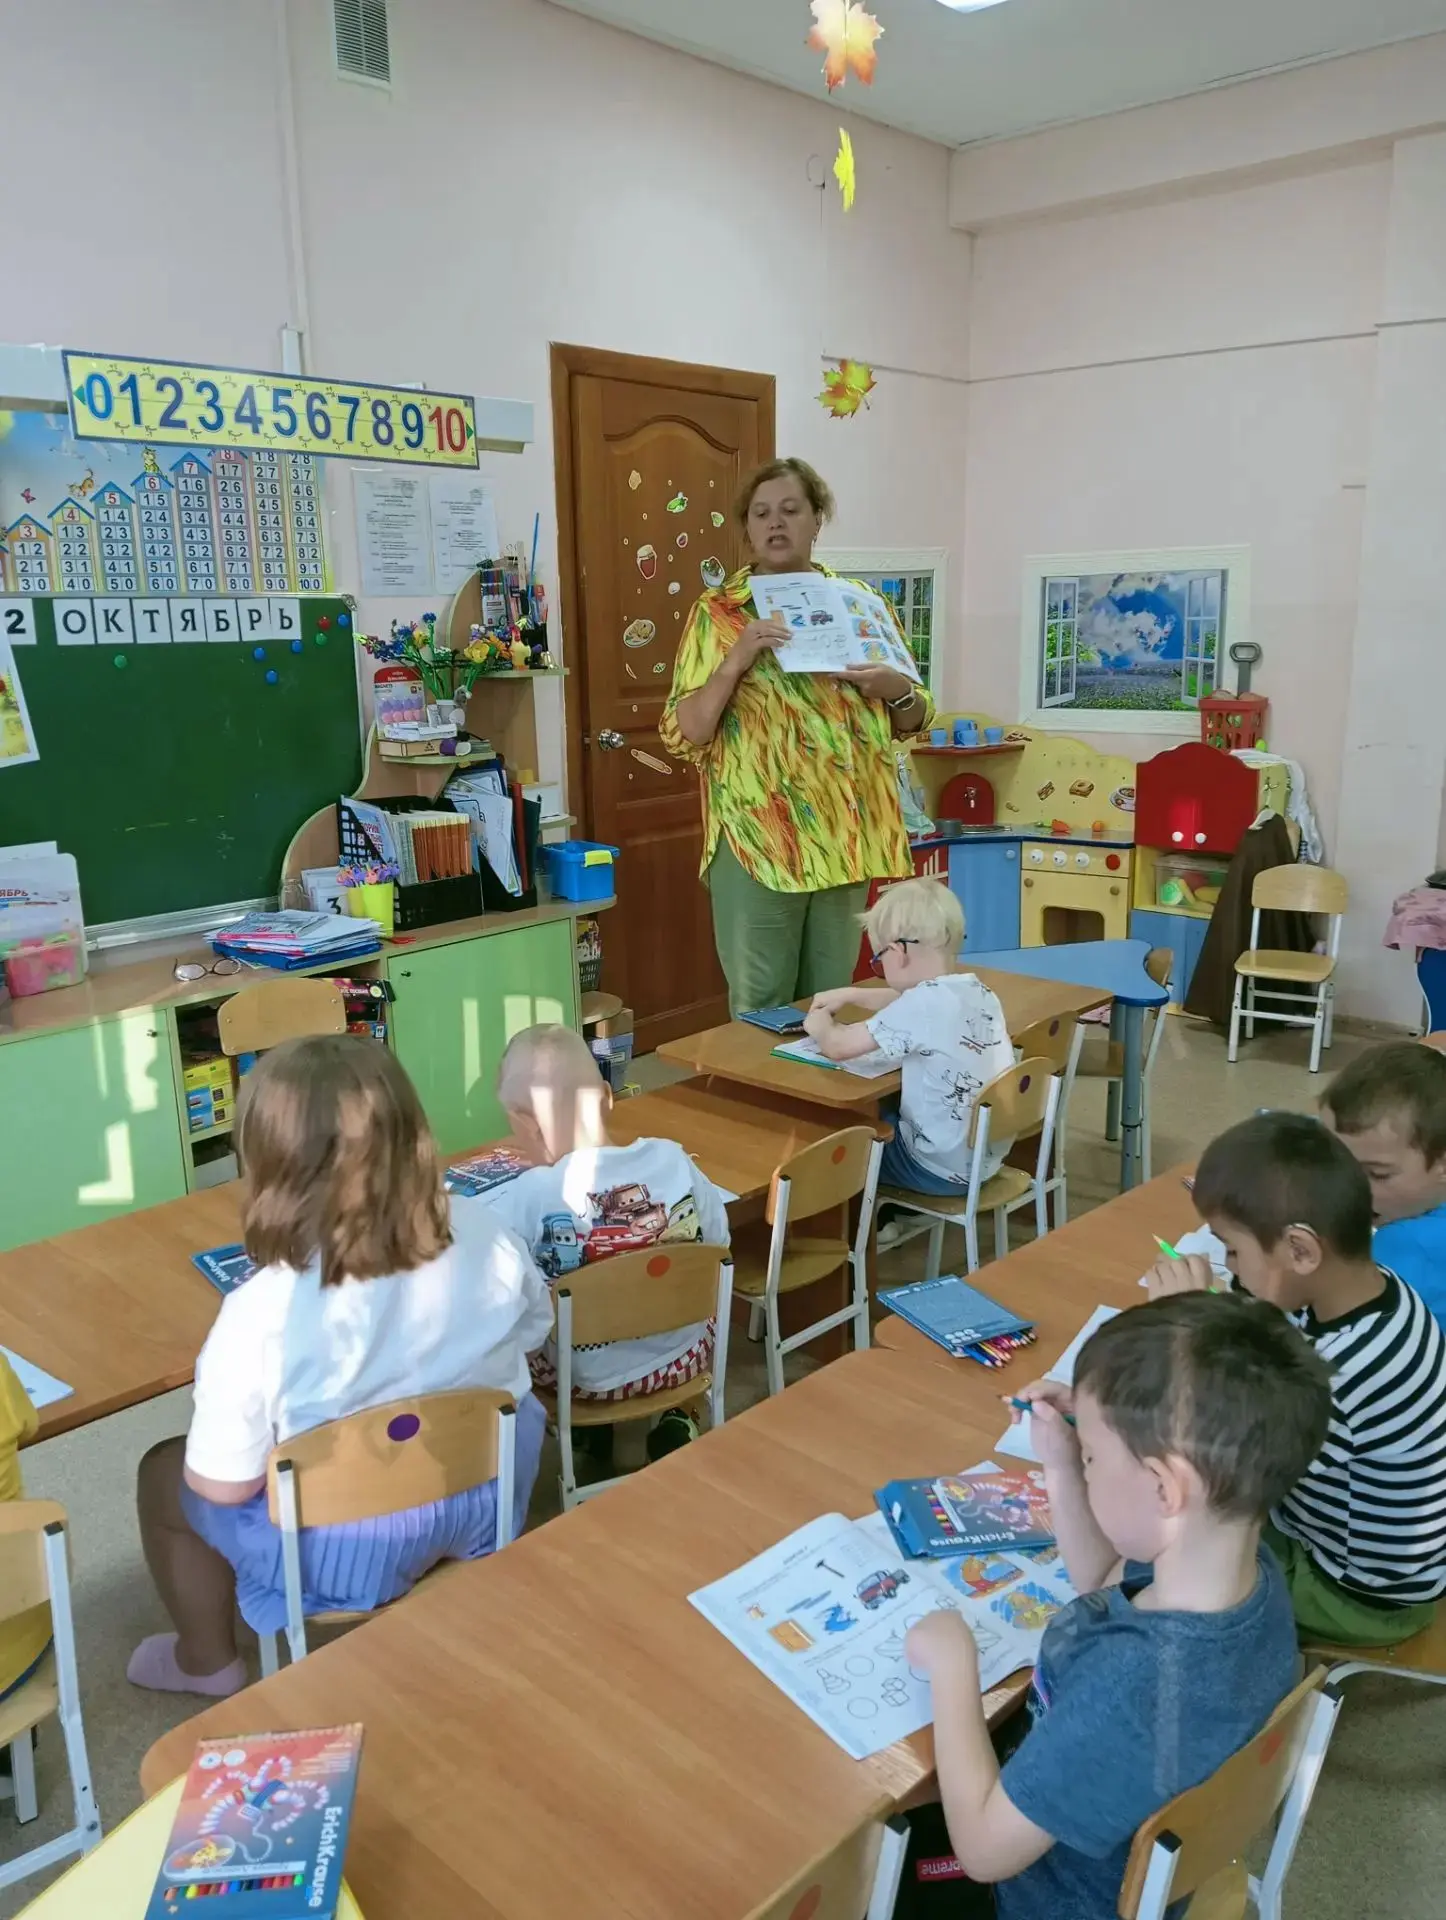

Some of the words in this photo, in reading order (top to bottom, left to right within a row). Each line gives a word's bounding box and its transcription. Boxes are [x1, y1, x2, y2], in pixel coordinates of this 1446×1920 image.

[86, 373, 112, 418] 0
[119, 374, 141, 424] 1
[156, 378, 187, 428] 2
[195, 381, 224, 431] 3
[235, 385, 263, 434] 4
[273, 389, 297, 436] 5
[307, 392, 331, 439] 6
[338, 396, 359, 441] 7
[371, 400, 394, 445] 8
[402, 404, 423, 448] 9
[429, 406, 465, 452] 10
[224, 450, 231, 459] 8
[256, 452, 261, 460] 1
[268, 452, 274, 461] 8
[291, 454, 298, 463] 2
[303, 455, 310, 464] 8
[187, 464, 194, 473] 7
[220, 465, 225, 475] 1
[232, 465, 238, 476] 7
[257, 467, 263, 477] 2
[269, 468, 275, 478] 7
[293, 469, 299, 479] 3
[304, 470, 310, 480] 7
[149, 478, 156, 488] 6
[183, 480, 188, 490] 1
[195, 480, 203, 491] 6
[221, 481, 228, 492] 2
[234, 482, 240, 492] 6
[258, 483, 264, 493] 3
[271, 484, 277, 494] 6
[294, 485, 300, 495] 4
[306, 486, 312, 496] 6
[109, 494, 116, 503] 5
[144, 494, 149, 505] 1
[158, 495, 165, 505] 5
[184, 496, 191, 506] 2
[198, 496, 204, 507] 5
[222, 498, 229, 508] 3
[236, 498, 242, 508] 5
[259, 499, 266, 509] 4
[272, 500, 278, 510] 5
[295, 501, 301, 511] 5
[308, 501, 314, 511] 5
[67, 510, 75, 521] 4
[104, 510, 109, 520] 1
[118, 510, 125, 521] 4
[145, 511, 152, 522] 2
[159, 512, 166, 522] 4
[185, 512, 192, 523] 3
[199, 513, 205, 523] 4
[224, 514, 231, 524] 4
[237, 515, 243, 524] 4
[261, 515, 267, 526] 5
[273, 516, 280, 526] 4
[296, 517, 302, 527] 6
[308, 518, 315, 527] 4
[24, 526, 32, 536] 3
[62, 526, 68, 537] 1
[76, 526, 84, 538] 3
[105, 527, 112, 538] 2
[120, 527, 127, 538] 3
[147, 528, 154, 540] 3
[161, 528, 168, 539] 3
[187, 529, 194, 540] 4
[200, 530, 207, 540] 3
[226, 530, 232, 541] 5
[238, 531, 245, 541] 3
[262, 531, 268, 541] 6
[275, 532, 281, 542] 3
[297, 532, 303, 542] 7
[310, 533, 316, 543] 3
[19, 543, 25, 554] 1
[34, 543, 42, 555] 2
[63, 544, 71, 555] 2
[78, 544, 86, 555] 2
[106, 544, 114, 555] 3
[121, 544, 129, 556] 2
[149, 545, 156, 555] 4
[163, 545, 170, 556] 2
[189, 546, 195, 556] 5
[202, 546, 209, 556] 2
[227, 546, 233, 557] 6
[240, 547, 246, 557] 2
[263, 547, 269, 557] 7
[276, 548, 282, 558] 2
[299, 548, 305, 558] 8
[311, 548, 318, 558] 2
[20, 561, 28, 572] 2
[37, 561, 43, 572] 1
[65, 561, 73, 572] 3
[81, 561, 87, 572] 1
[109, 562, 116, 572] 4
[125, 562, 130, 572] 1
[151, 562, 157, 572] 5
[166, 562, 171, 572] 1
[190, 562, 197, 572] 6
[205, 562, 209, 572] 1
[228, 563, 234, 573] 7
[242, 563, 247, 573] 1
[265, 563, 271, 573] 8
[278, 564, 283, 573] 1
[300, 564, 306, 573] 9
[313, 564, 318, 573] 1
[22, 579, 30, 590] 3
[38, 579, 46, 590] 0
[68, 579, 75, 589] 4
[83, 579, 90, 589] 0
[111, 579, 118, 589] 5
[125, 578, 133, 589] 0
[152, 579, 159, 589] 6
[167, 579, 173, 589] 0
[192, 579, 198, 589] 7
[205, 579, 212, 589] 0
[230, 579, 236, 589] 8
[243, 579, 249, 589] 0
[266, 579, 272, 589] 9
[279, 579, 285, 589] 0
[300, 579, 309, 589] 10
[314, 579, 320, 590] 0
[4, 609, 26, 634] 2
[63, 608, 292, 634] ОКТЯБРЬ
[309, 1806, 342, 1907] ErichKrause
